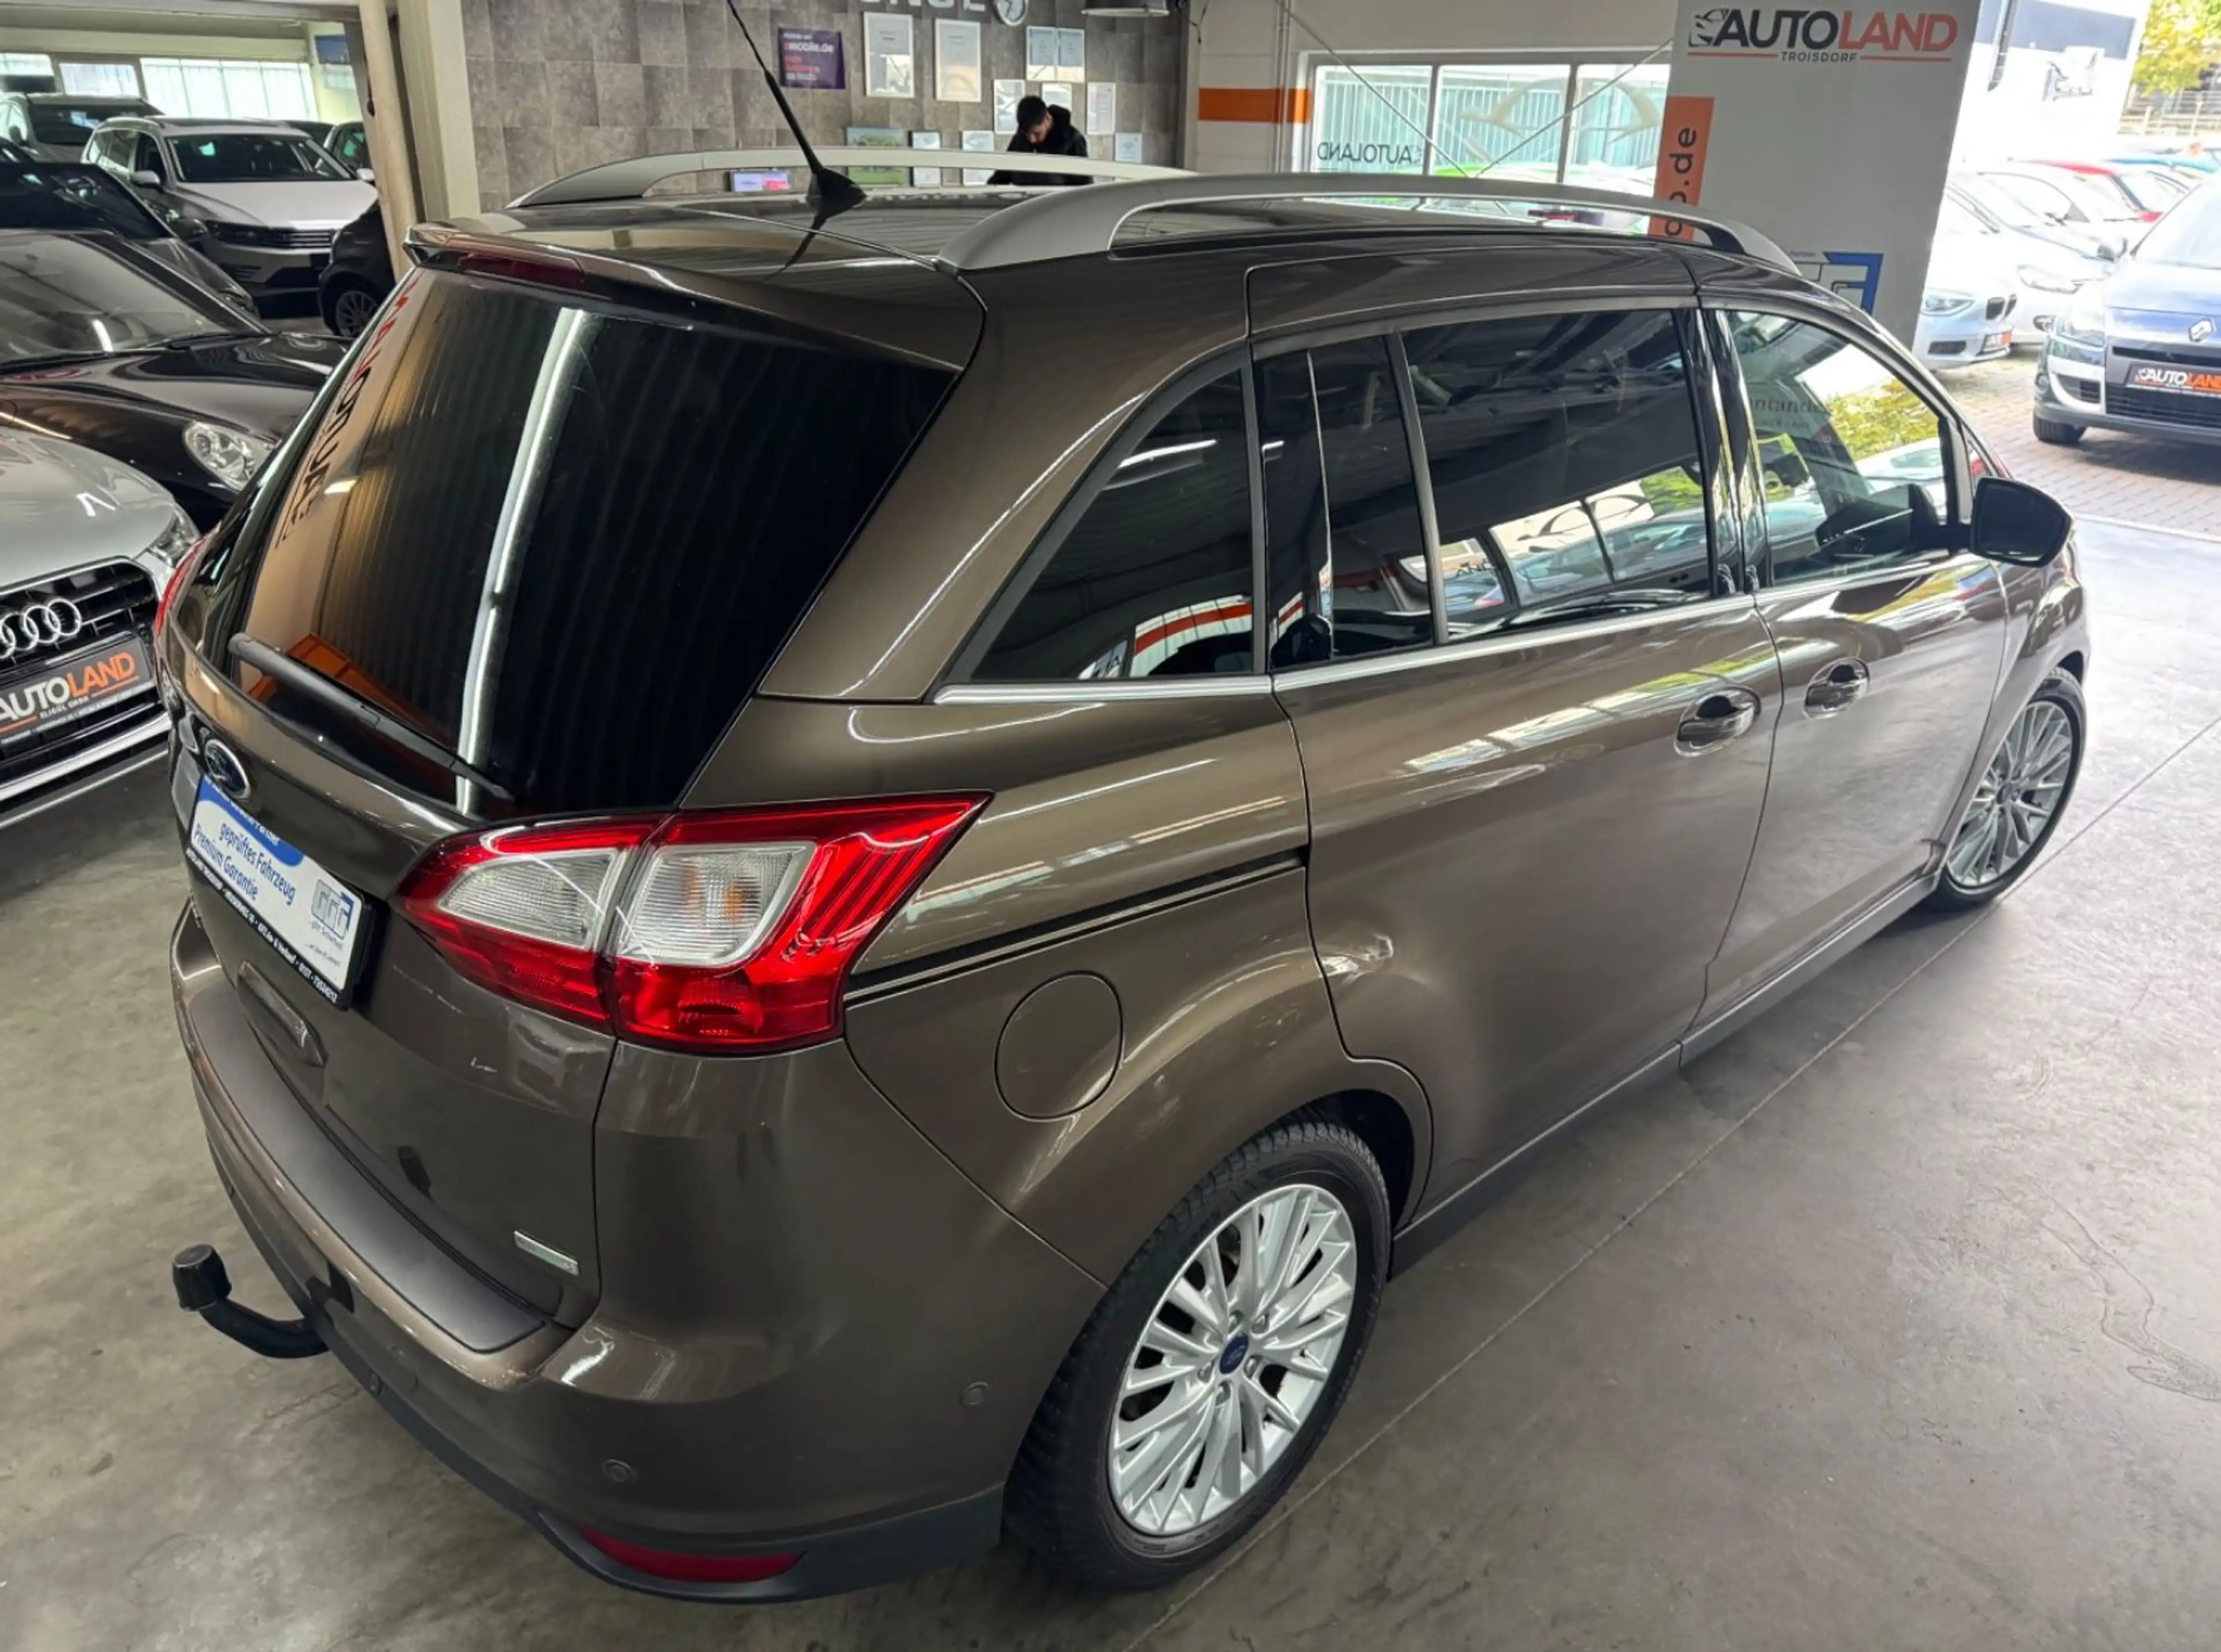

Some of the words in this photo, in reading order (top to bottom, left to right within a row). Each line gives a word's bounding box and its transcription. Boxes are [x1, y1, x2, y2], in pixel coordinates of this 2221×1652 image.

[1713, 8, 1958, 51] AUTOLAND
[1781, 51, 1858, 63] TROISDORF
[219, 822, 257, 866] geprüftes
[256, 851, 296, 906] Fahrzeug
[223, 854, 258, 901] Garantie
